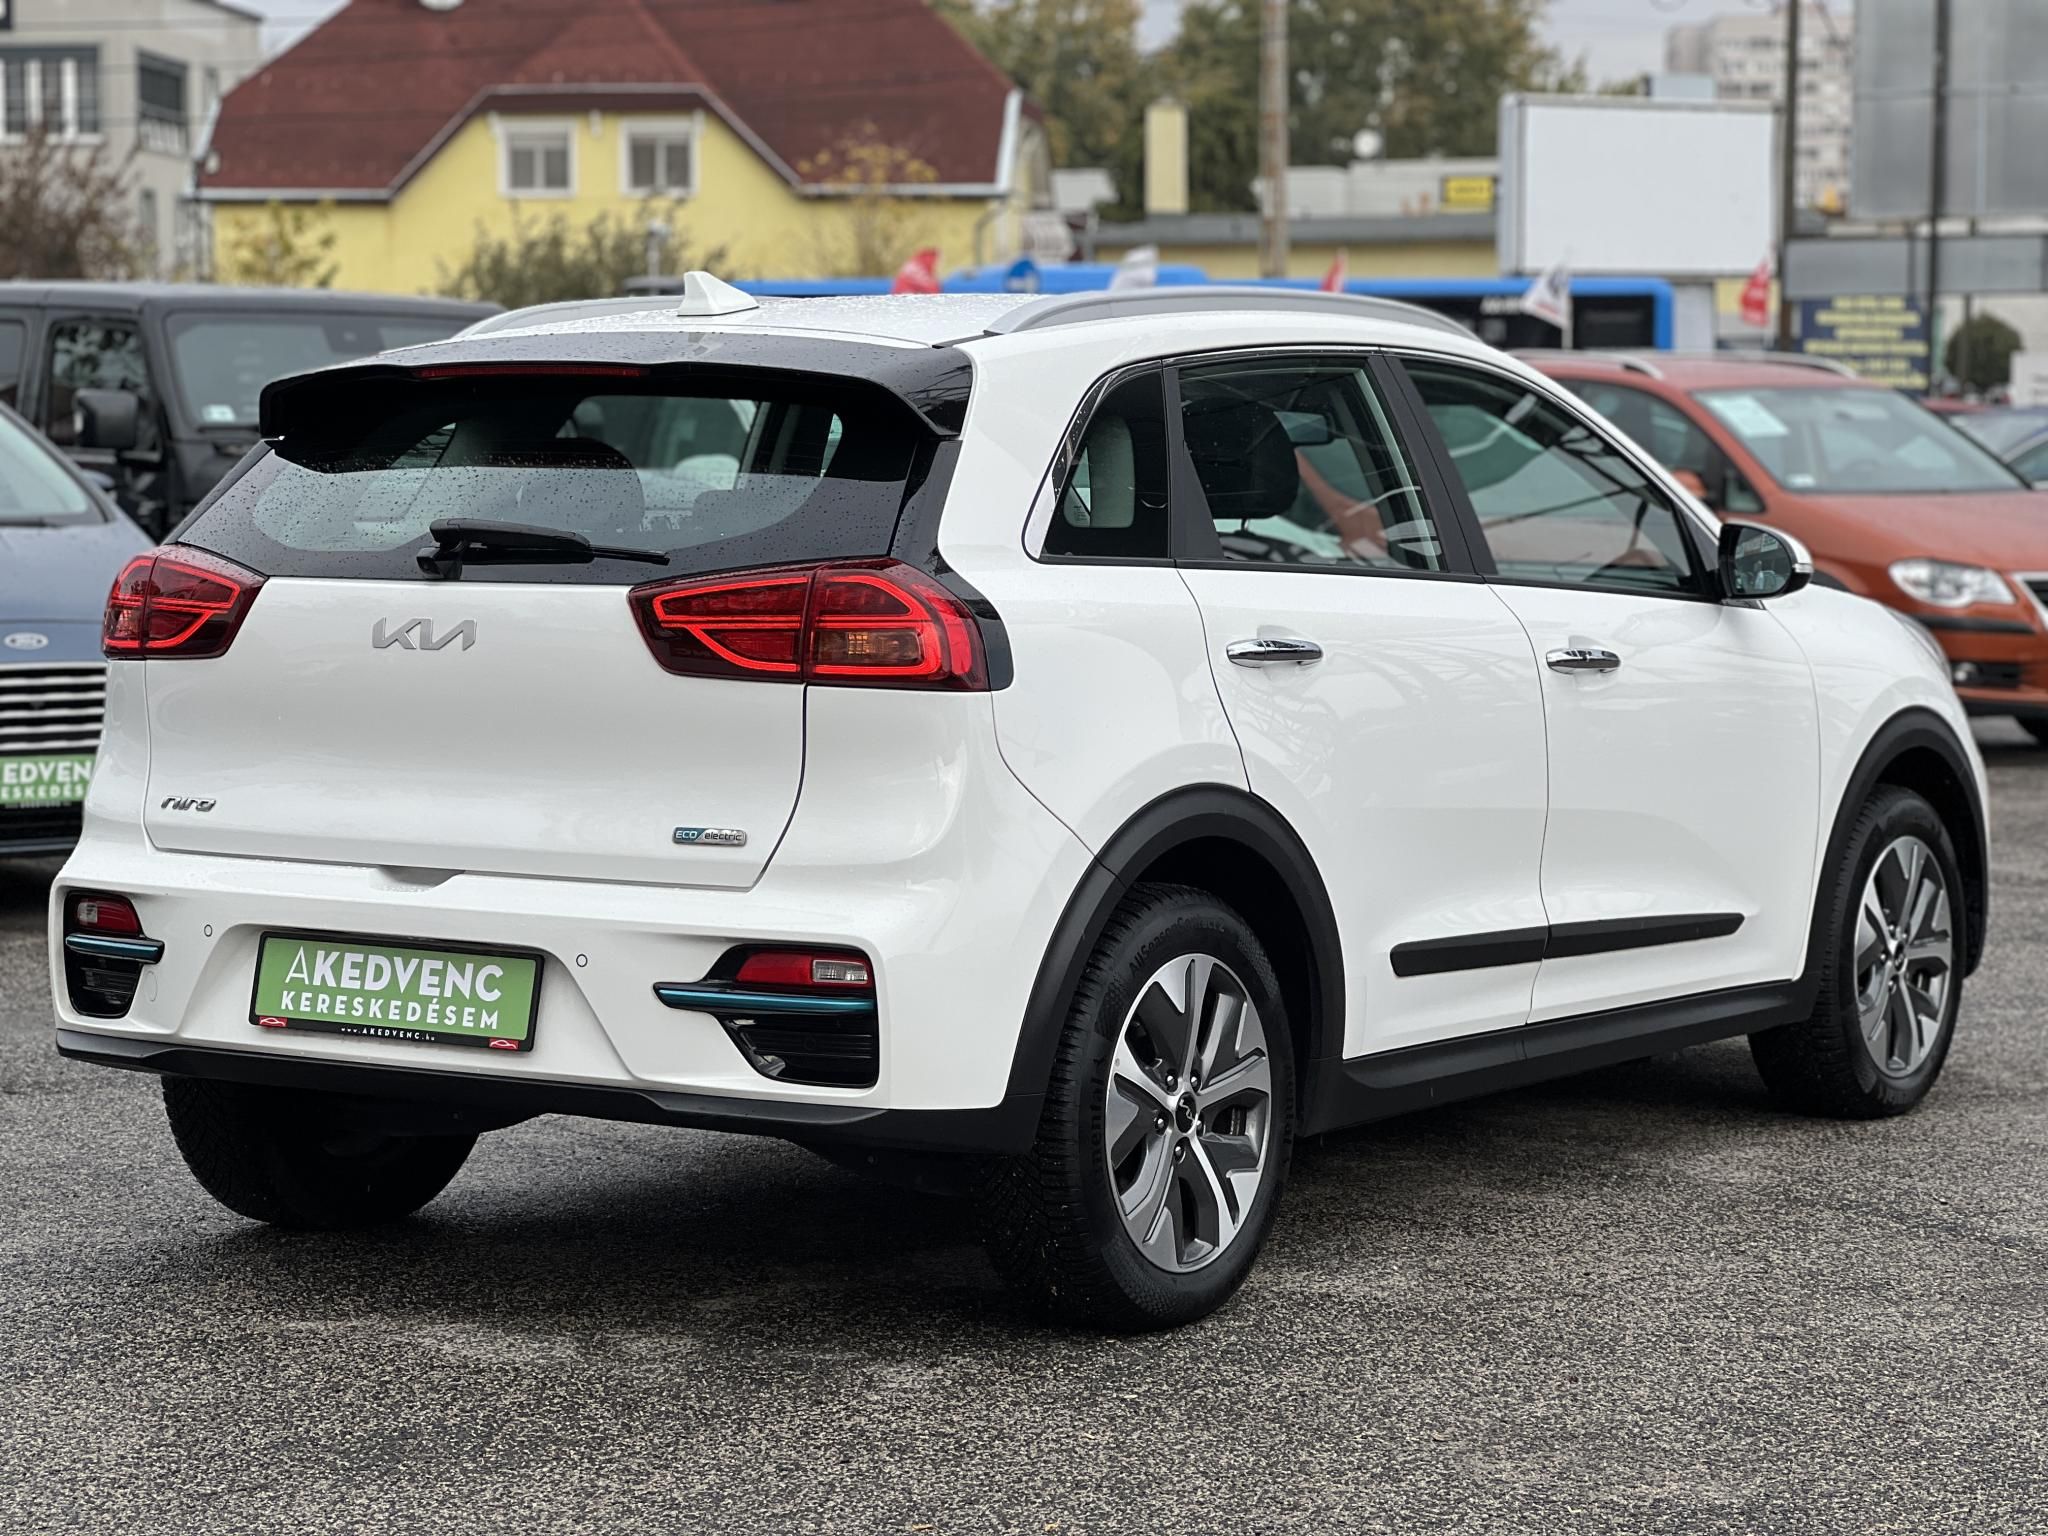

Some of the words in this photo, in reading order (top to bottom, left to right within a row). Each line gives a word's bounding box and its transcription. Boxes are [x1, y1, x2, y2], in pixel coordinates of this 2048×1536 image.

[675, 830, 698, 839] ECO
[704, 832, 742, 841] electric
[285, 946, 504, 1002] AKEDVENC
[280, 990, 498, 1029] KERESKEDÉSEM
